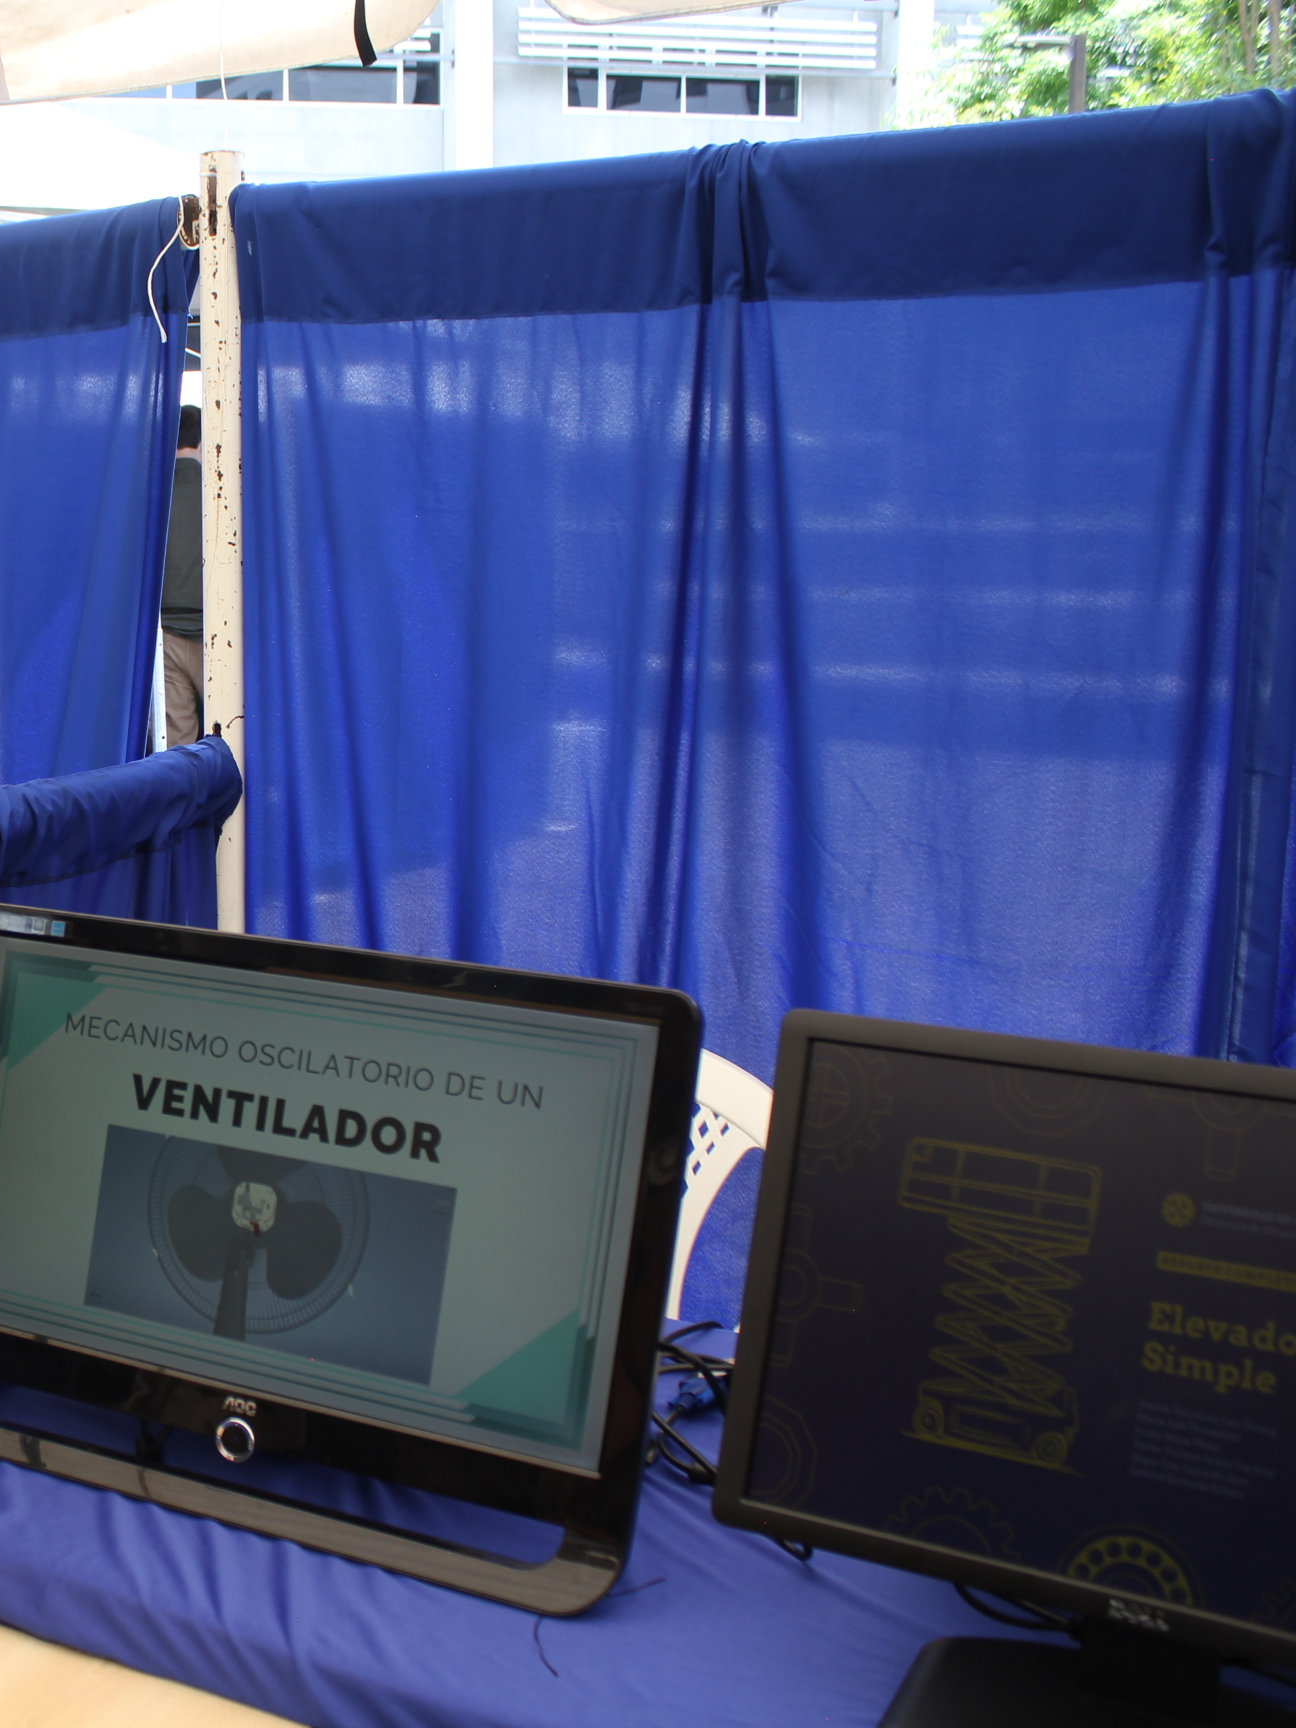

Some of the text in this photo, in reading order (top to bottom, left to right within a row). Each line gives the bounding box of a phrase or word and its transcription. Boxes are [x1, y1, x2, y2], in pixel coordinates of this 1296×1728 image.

[65, 1012, 544, 1110] MECANISMO OSCILATORIO DE UN
[132, 1073, 442, 1164] VENTILADOR
[1147, 1300, 1296, 1357] Elevado
[1141, 1340, 1278, 1395] Simple
